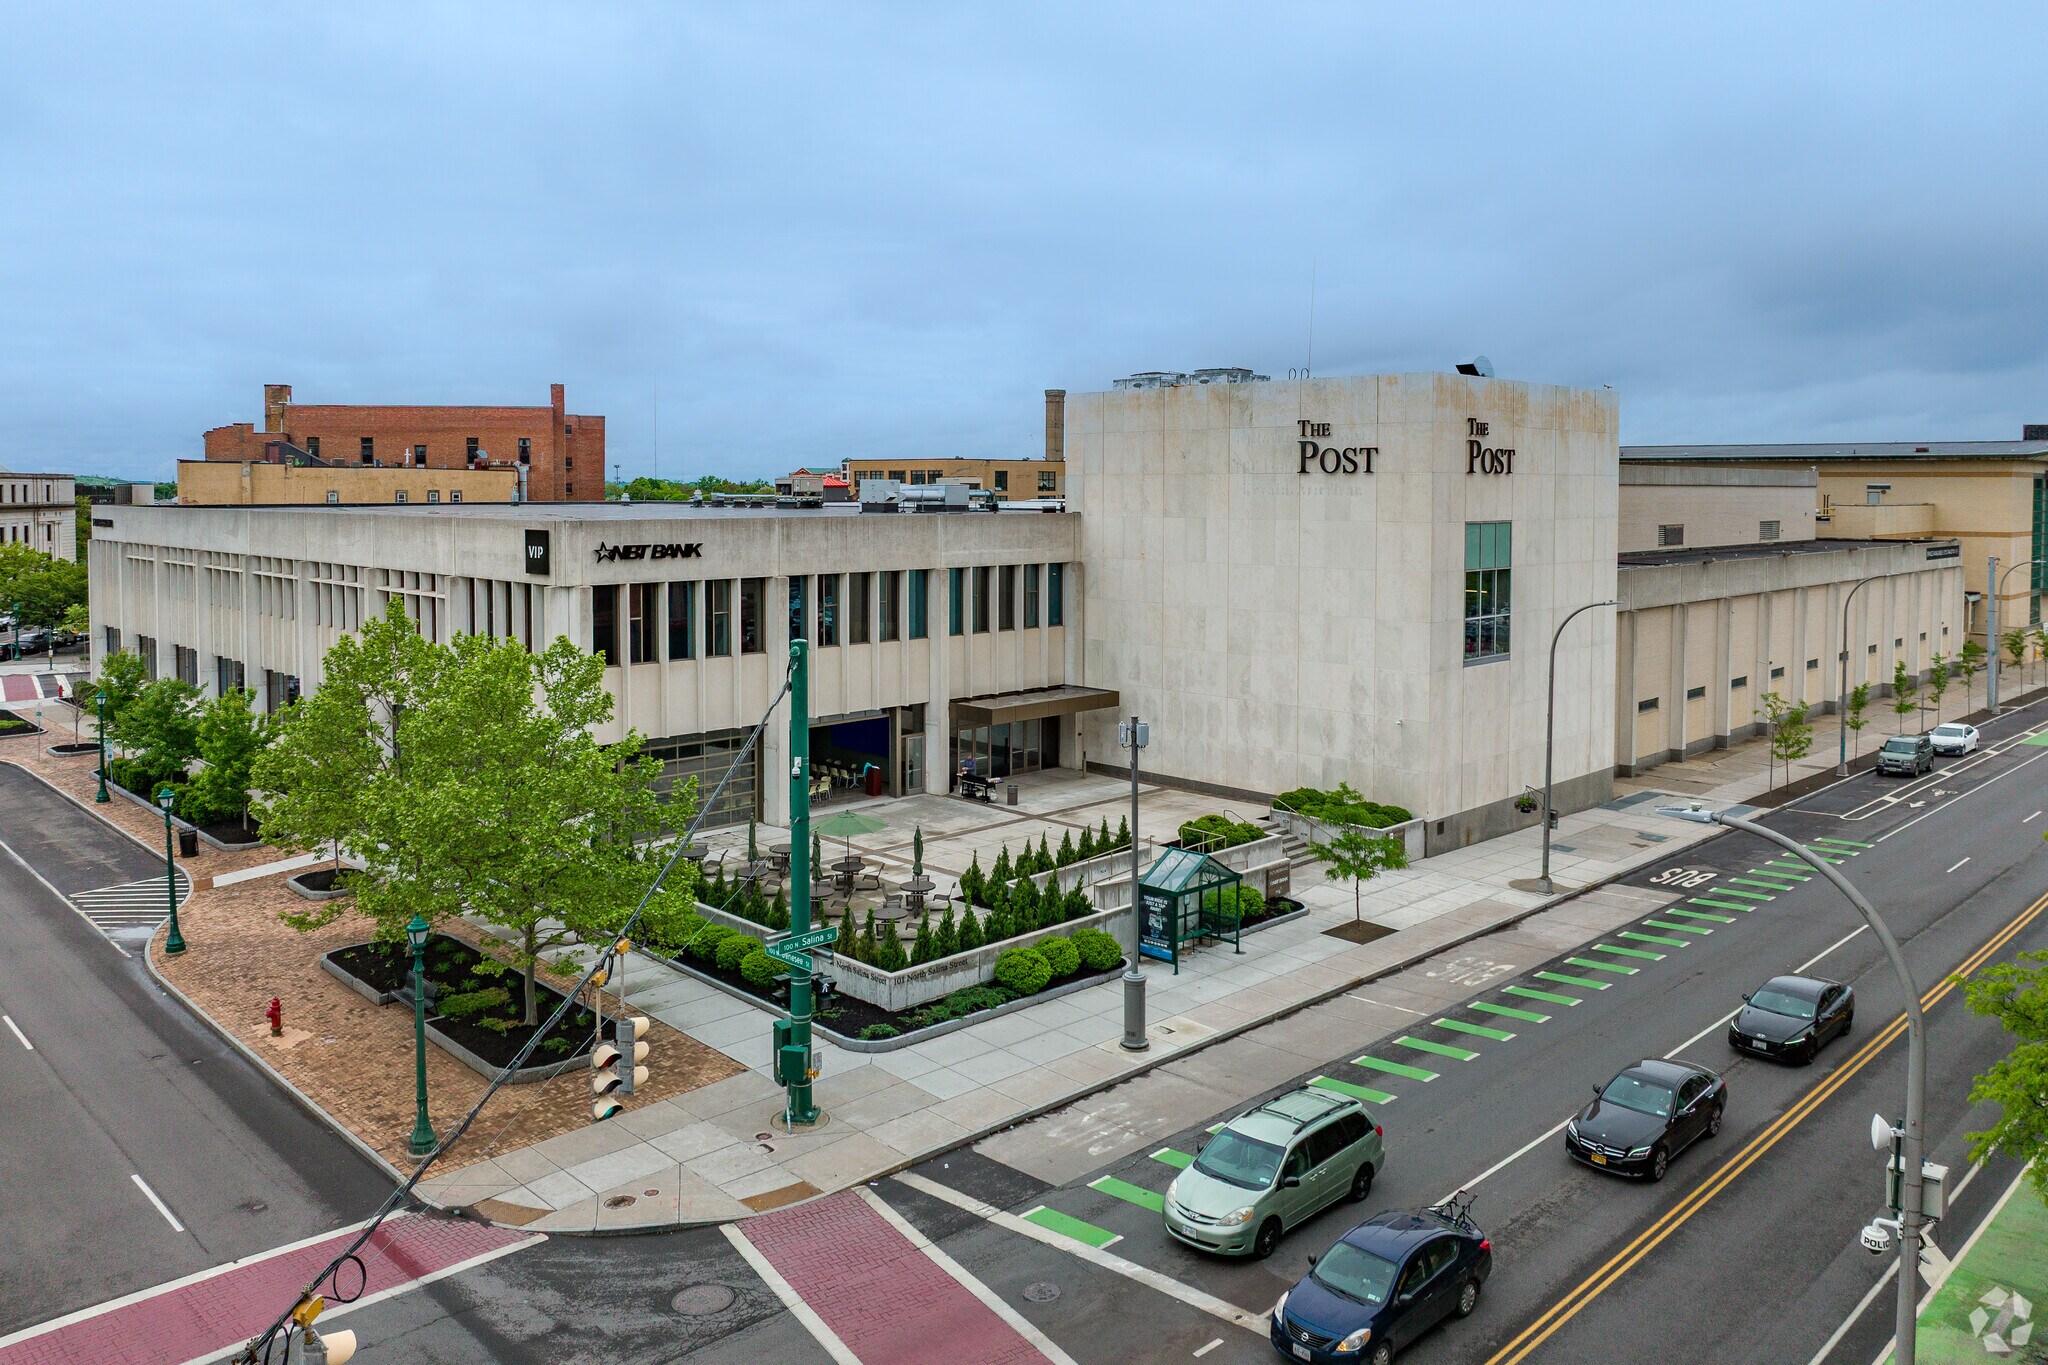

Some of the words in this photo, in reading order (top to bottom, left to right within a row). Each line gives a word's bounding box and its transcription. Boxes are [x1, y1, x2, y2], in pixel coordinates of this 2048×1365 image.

[1297, 419, 1331, 437] THE
[1467, 417, 1490, 436] THE
[1297, 440, 1379, 474] POST
[1466, 439, 1516, 475] POST
[528, 545, 544, 559] VIP
[611, 544, 652, 560] NBT
[650, 542, 704, 560] BANK
[1649, 868, 1718, 888] BUS
[783, 943, 794, 951] 100
[801, 934, 824, 946] Salina
[805, 960, 810, 968] St
[836, 960, 853, 973] North
[852, 967, 870, 980] Salina
[870, 973, 887, 986] Street
[894, 978, 904, 986] 101
[906, 971, 927, 983] North
[927, 964, 948, 976] Salina
[949, 958, 968, 970] Street
